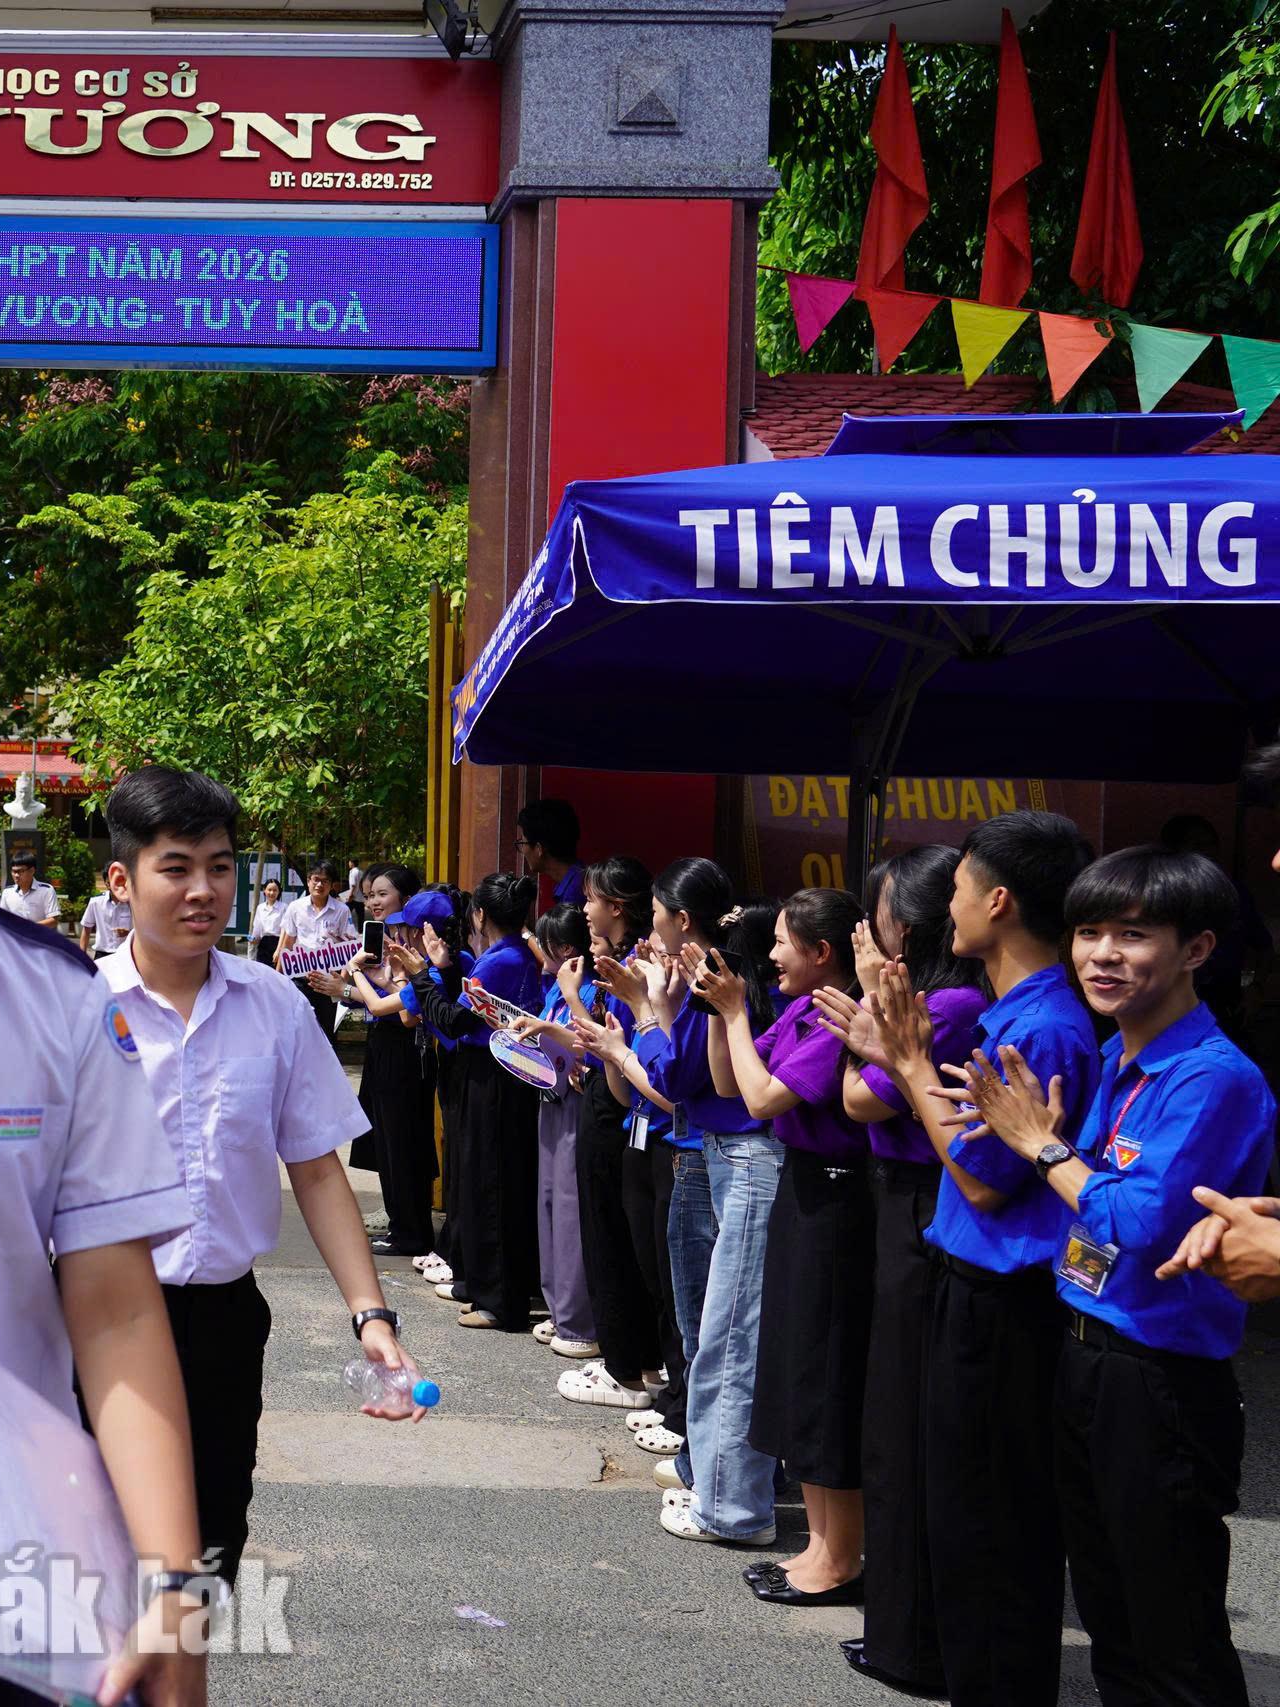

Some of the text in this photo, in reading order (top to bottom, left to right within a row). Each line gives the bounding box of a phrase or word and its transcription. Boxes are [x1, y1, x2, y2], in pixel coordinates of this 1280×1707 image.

[74, 68, 130, 97] CƠ
[143, 62, 199, 98] SỞ
[269, 172, 433, 190] ĐT: 02573.829.752
[87, 240, 183, 281] NĂM
[196, 248, 291, 283] 2026
[173, 297, 264, 331] TUY
[275, 291, 372, 334] HOÀ
[678, 488, 1258, 590] TIÊM CHỦNG
[769, 776, 851, 828] ĐẠT
